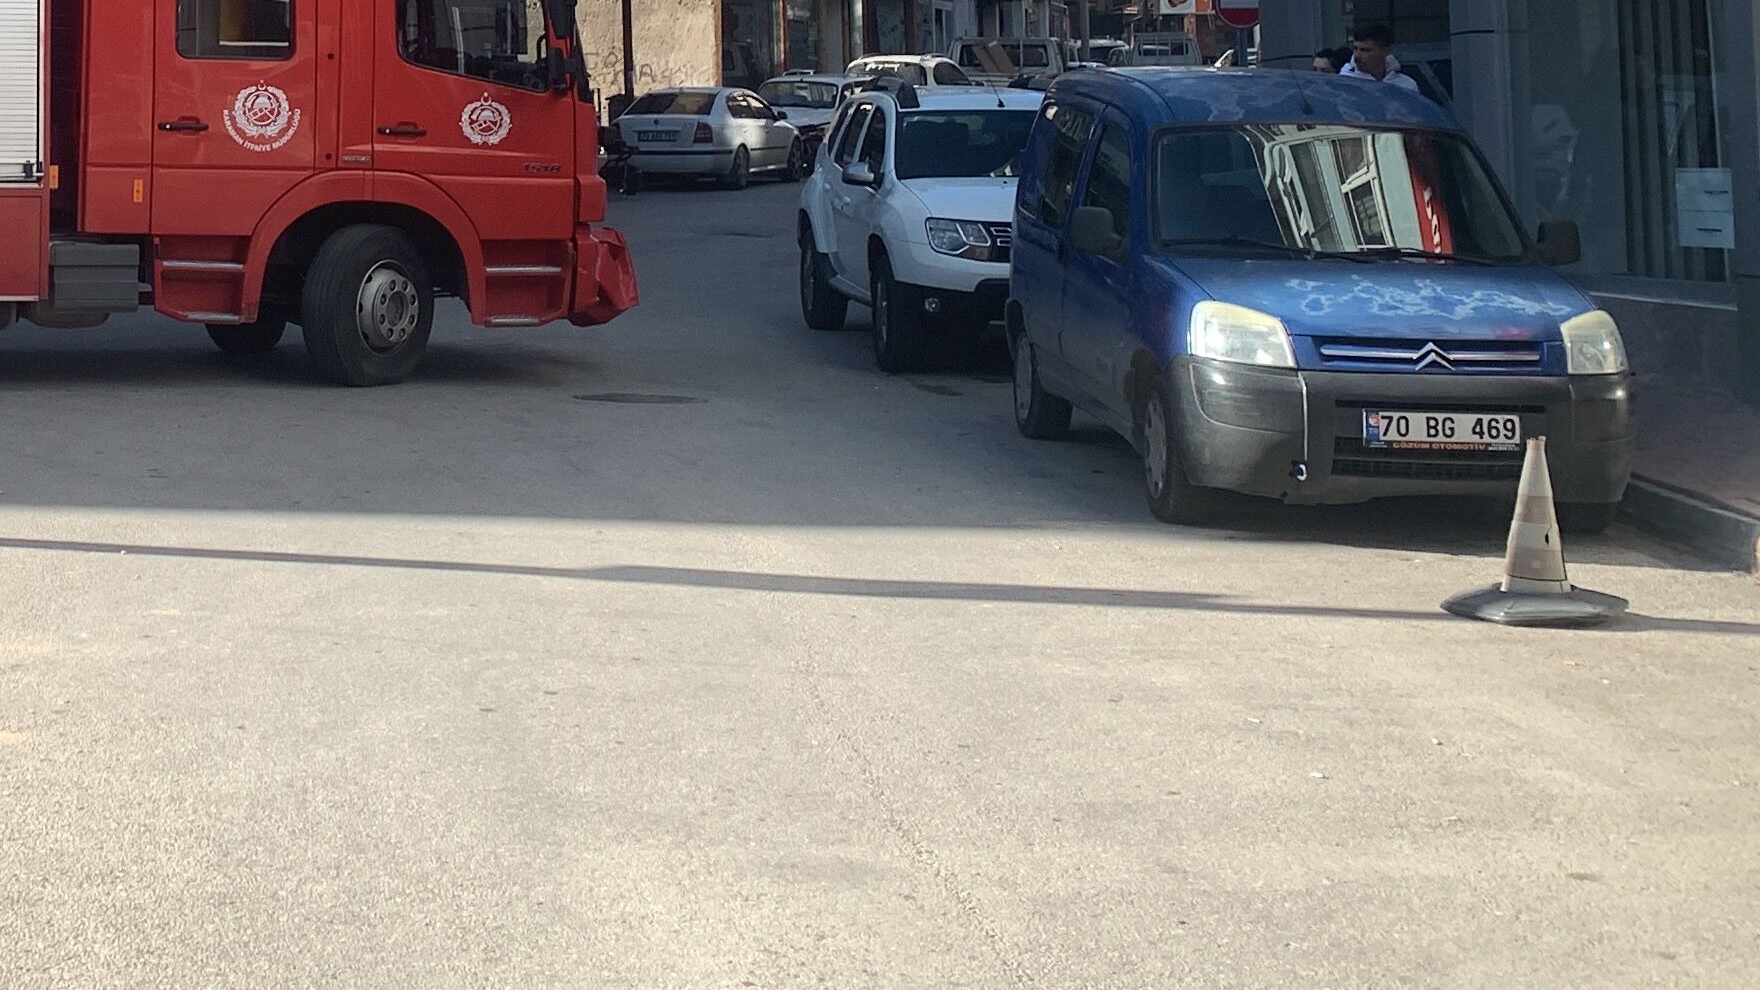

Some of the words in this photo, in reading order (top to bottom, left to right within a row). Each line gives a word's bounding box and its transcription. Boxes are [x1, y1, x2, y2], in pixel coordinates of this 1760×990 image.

[1380, 415, 1410, 438] 70
[1426, 416, 1456, 439] BG
[1471, 417, 1516, 441] 469
